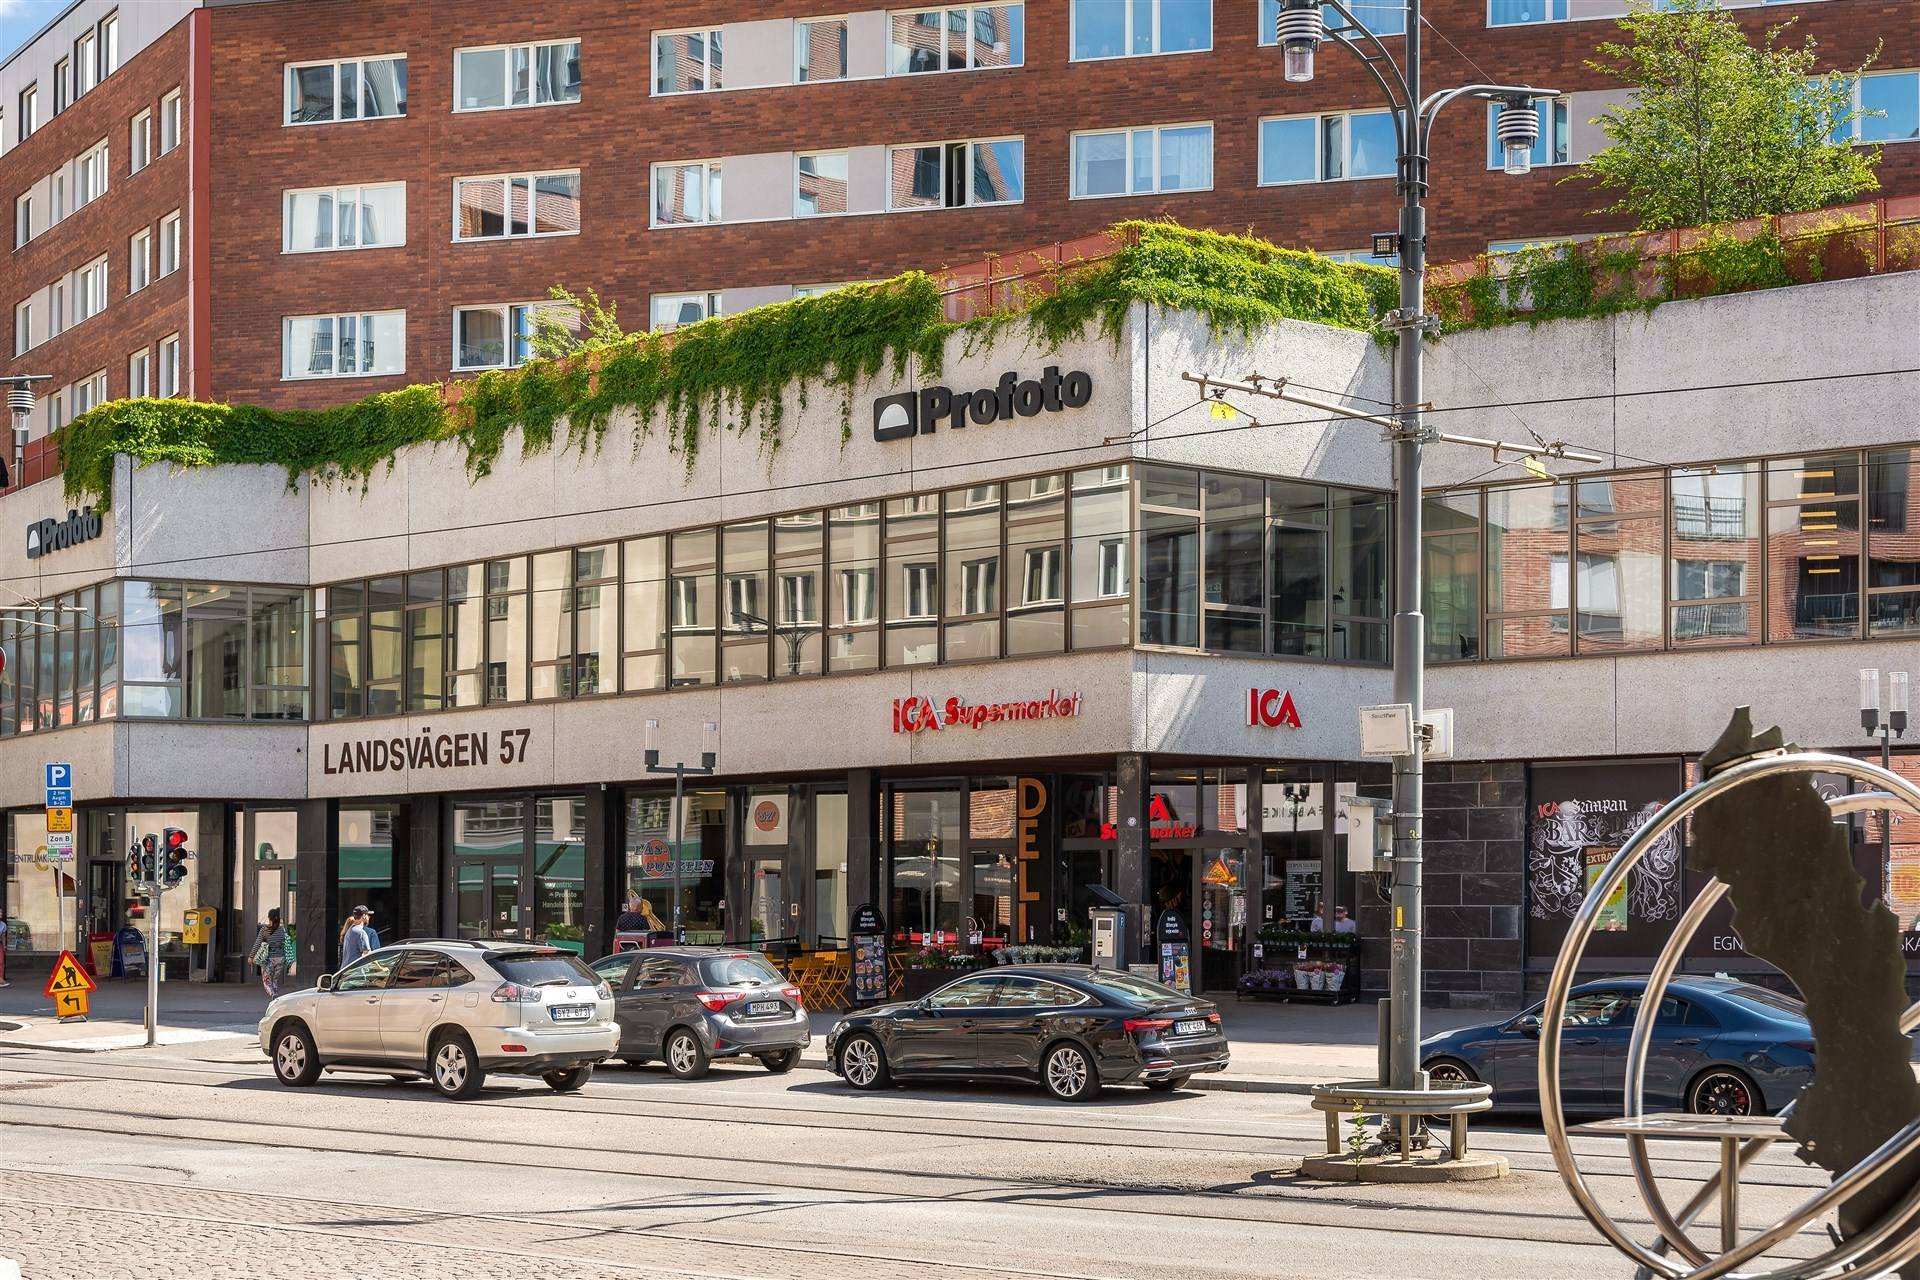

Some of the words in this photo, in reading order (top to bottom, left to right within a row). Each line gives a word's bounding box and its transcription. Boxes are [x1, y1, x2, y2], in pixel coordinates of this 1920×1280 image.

[919, 365, 1092, 435] Profoto
[40, 505, 102, 556] Profoto
[892, 696, 943, 734] ICA
[944, 688, 1083, 730] Supermarket
[1247, 687, 1302, 729] ICA
[324, 727, 488, 775] LANDSVÄGEN
[499, 728, 531, 765] 57
[51, 766, 66, 786] P
[1537, 801, 1561, 817] ICA
[1547, 818, 1589, 843] BAR
[1018, 777, 1047, 944] DELI
[1586, 851, 1618, 864] EXTRAP
[1713, 936, 1743, 951] EGN
[557, 1008, 570, 1018] SYZ
[752, 1003, 765, 1013] MPH
